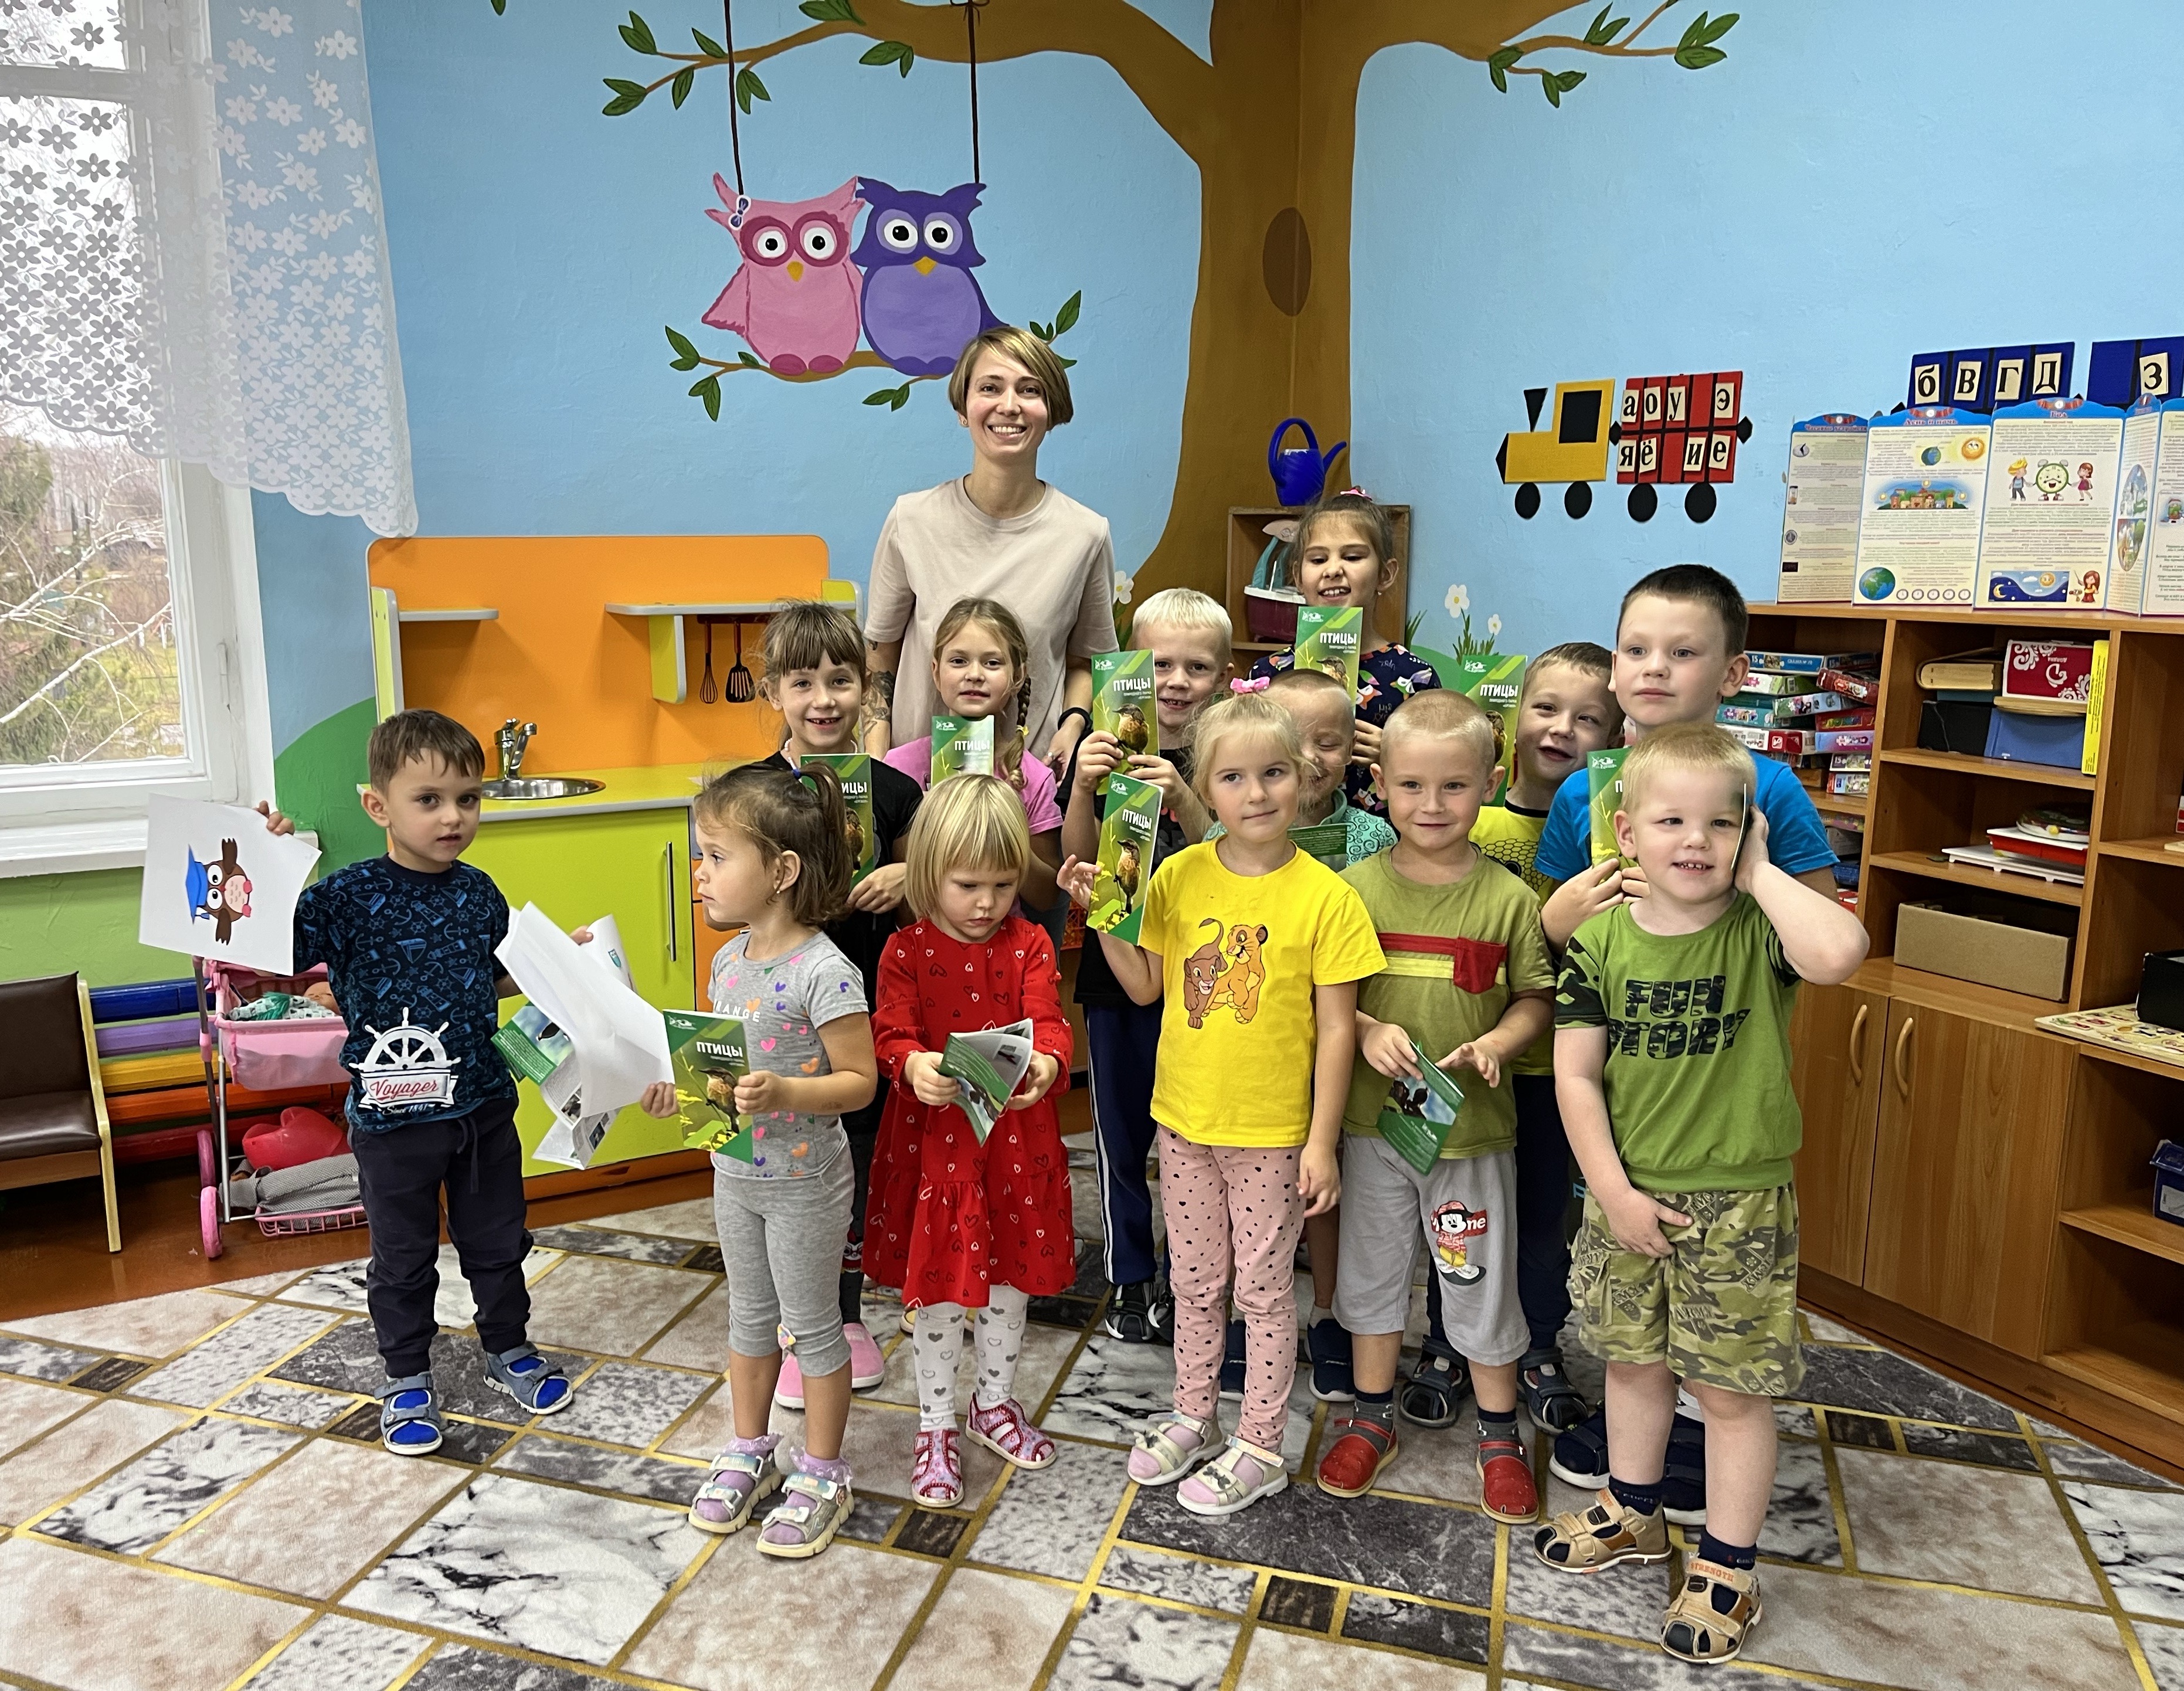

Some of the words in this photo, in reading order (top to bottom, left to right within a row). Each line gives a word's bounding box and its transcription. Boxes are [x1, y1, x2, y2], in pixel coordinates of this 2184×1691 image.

[1320, 633, 1357, 645] ПТИЦЫ
[1751, 655, 1758, 663] 15
[1113, 677, 1151, 691] ПТИЦЫ
[1480, 684, 1519, 698] ПТИЦЫ
[955, 740, 990, 751] ПТИЦЫ
[841, 782, 867, 794] ИЦЫ
[1122, 809, 1152, 830] ПТИЦЫ
[1625, 975, 1726, 1018] FUN
[696, 1041, 743, 1057] ПТИЦЫ
[370, 1079, 439, 1100] Voyager
[382, 1105, 406, 1115] Since
[1691, 1563, 1734, 1582] STRENGTH
